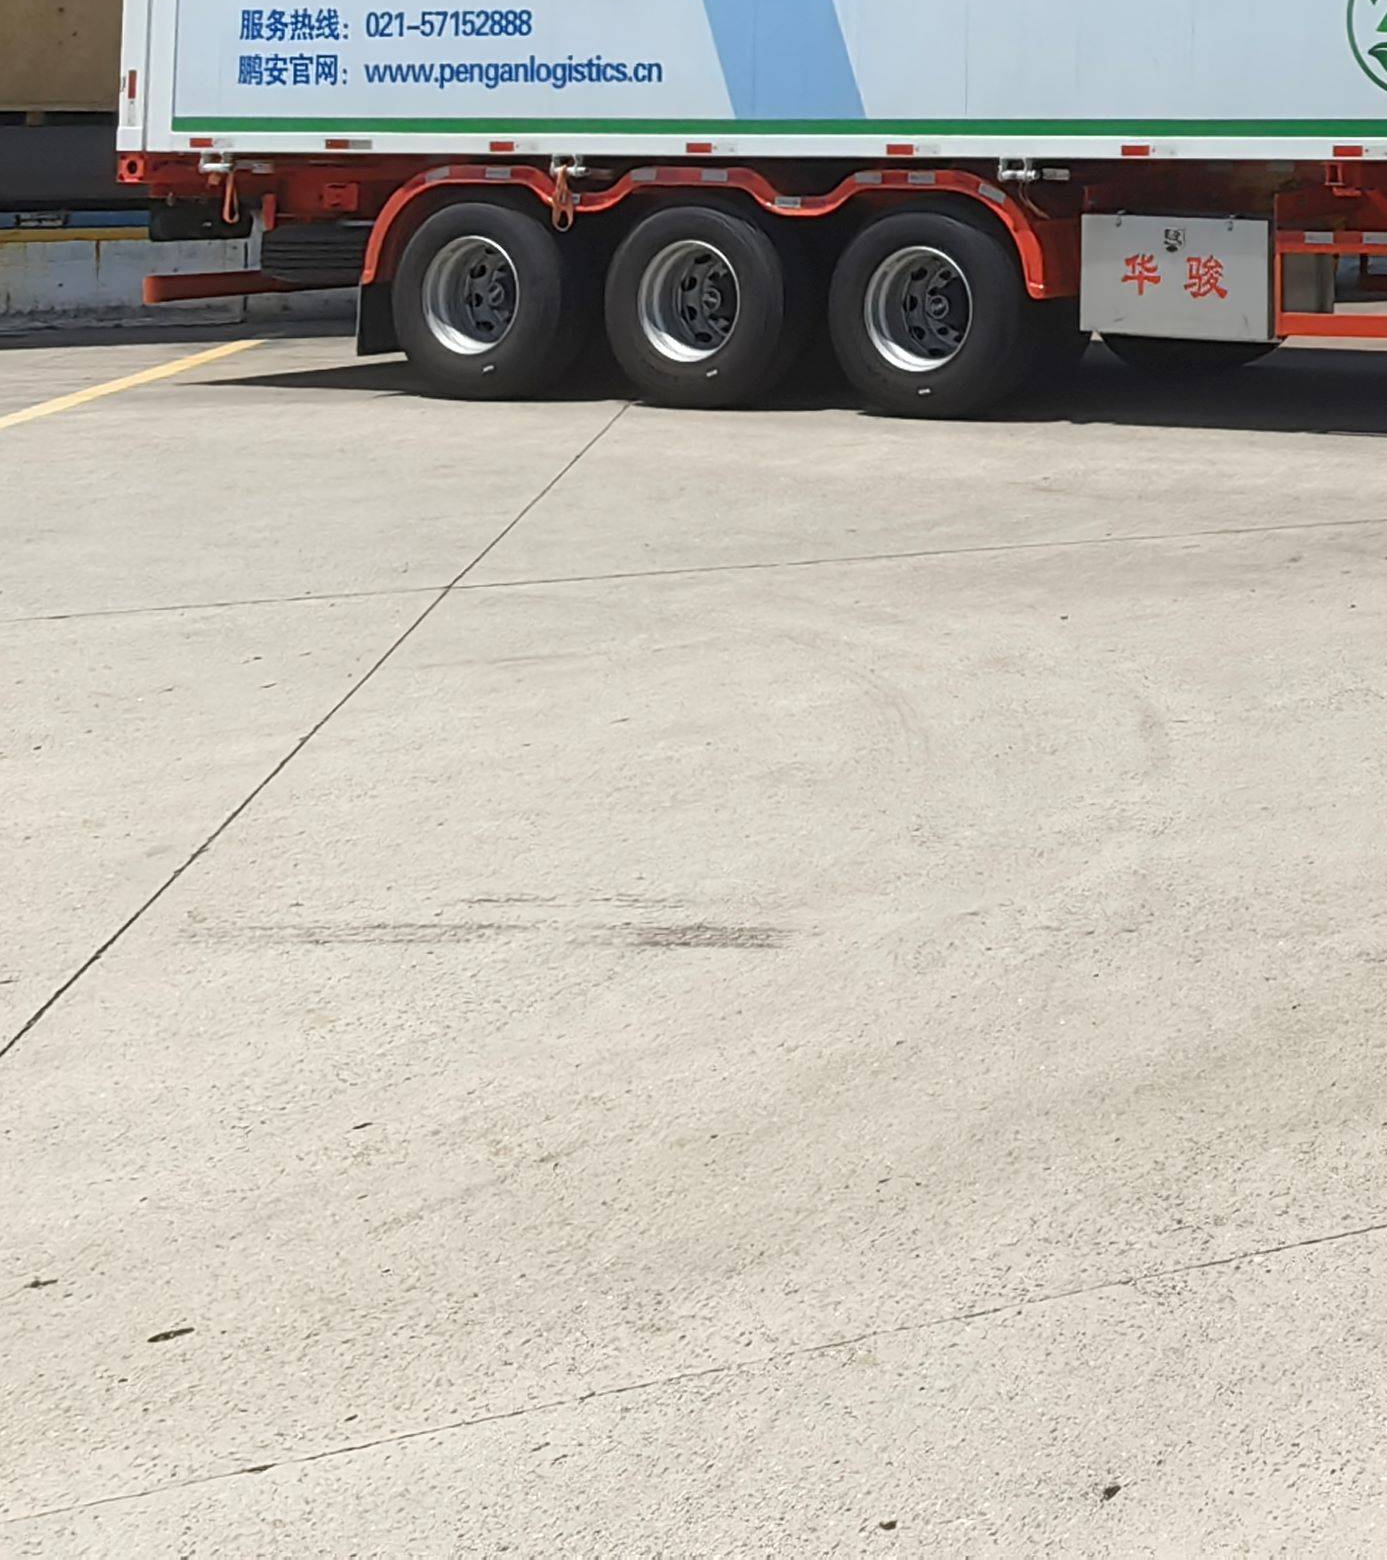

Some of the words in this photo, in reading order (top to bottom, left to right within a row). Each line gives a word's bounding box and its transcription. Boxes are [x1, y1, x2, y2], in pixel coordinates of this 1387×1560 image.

[365, 9, 533, 38] 021-57152888
[364, 55, 663, 90] www.penganlogistics.cn
[1121, 252, 1228, 300] 华骏
